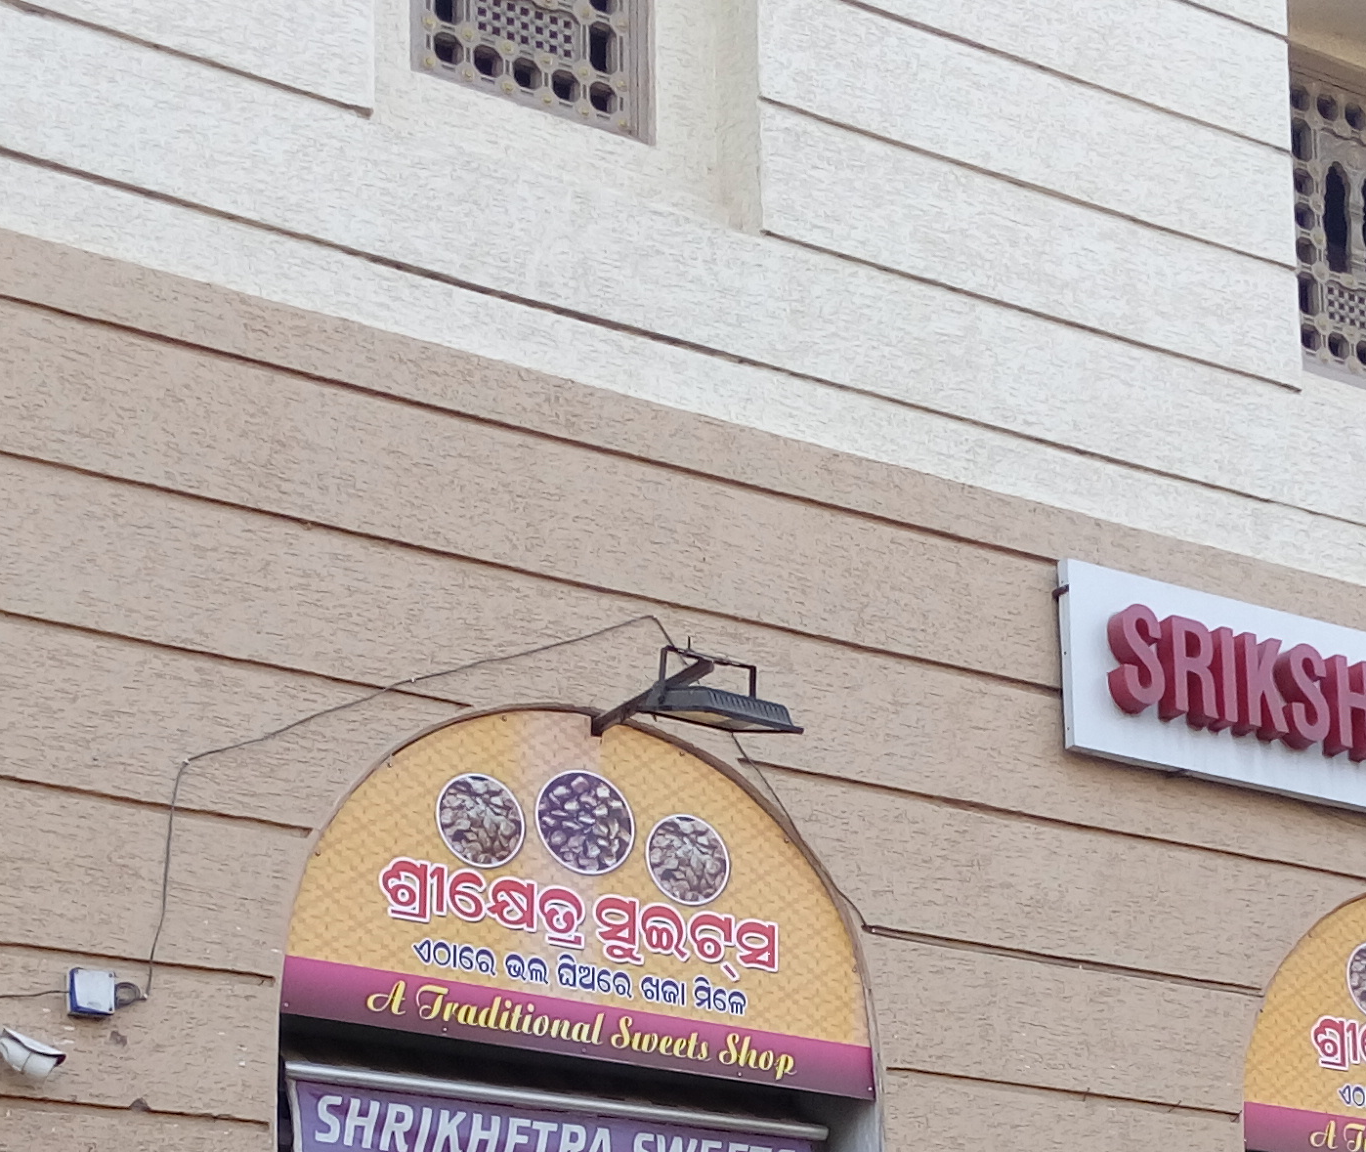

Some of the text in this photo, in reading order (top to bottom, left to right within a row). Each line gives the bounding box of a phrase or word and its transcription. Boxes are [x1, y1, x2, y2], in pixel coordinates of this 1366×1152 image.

[379, 858, 585, 949] ଶ୍ରୀକ୍ଷେତ୍ର
[413, 940, 747, 1015] ଏଠାରେ ଭଲ ଘିଅରେ ଖଜା ମିଳେ
[367, 980, 797, 1080] A Traditional Sweets Shop
[1309, 1121, 1338, 1150] A
